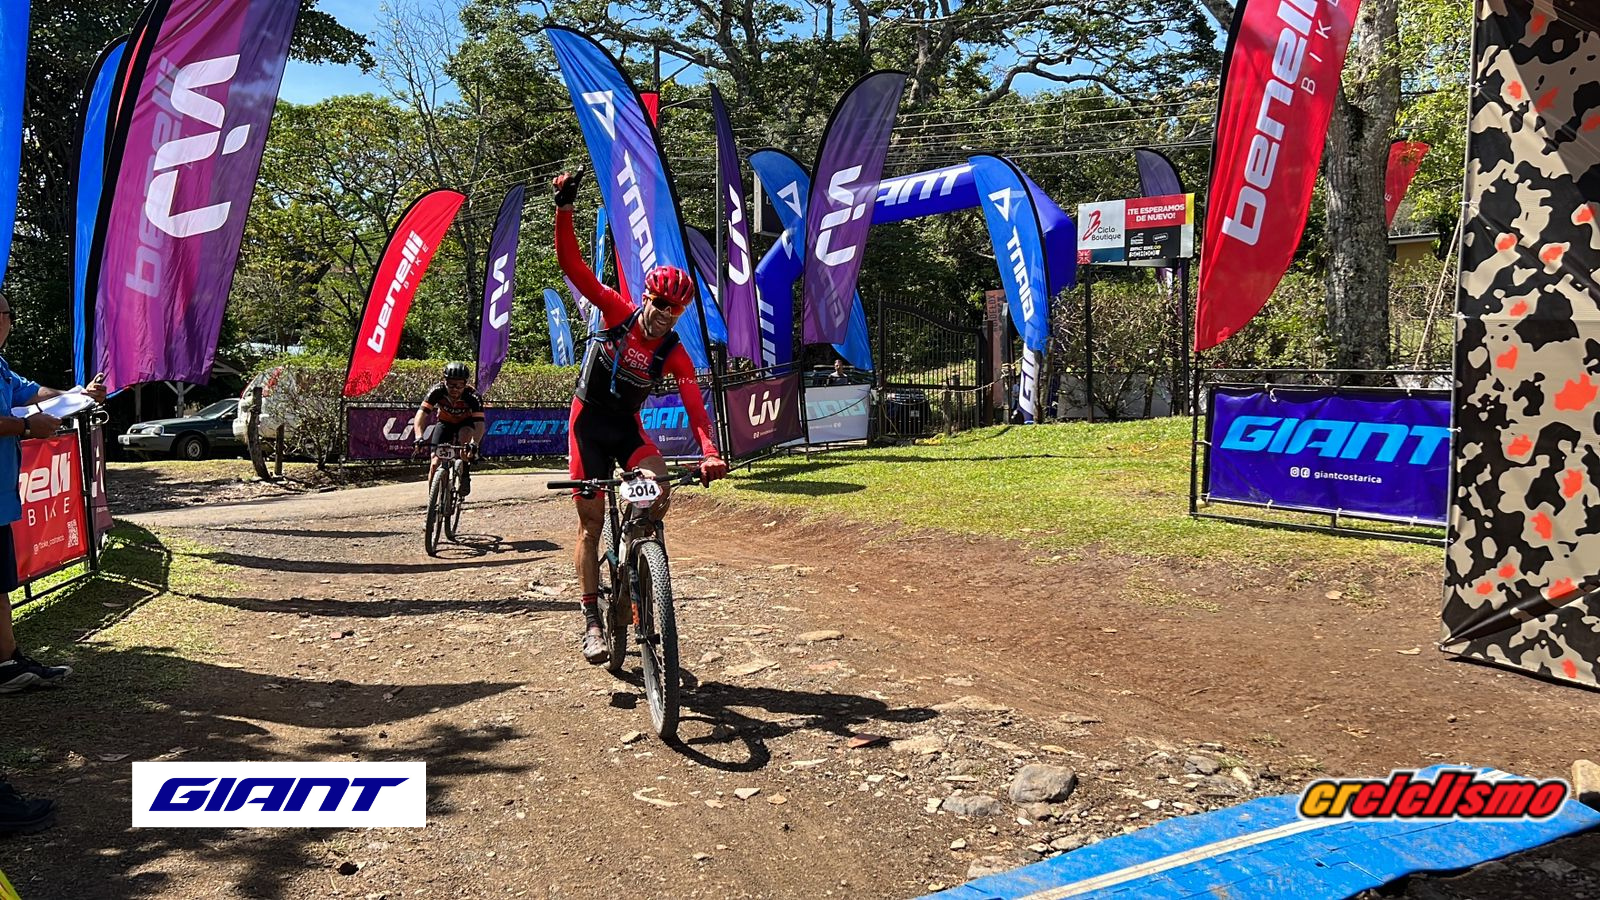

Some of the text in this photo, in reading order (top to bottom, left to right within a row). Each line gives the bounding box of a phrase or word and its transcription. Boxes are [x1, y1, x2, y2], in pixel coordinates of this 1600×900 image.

[1222, 0, 1318, 246] benell
[1136, 212, 1176, 222] DE NUEVO!
[1140, 203, 1185, 214] ESPERAMOS
[1091, 233, 1122, 241] Boutique
[367, 230, 424, 354] benelli
[628, 348, 649, 366] CICL
[640, 406, 690, 430] GIAN
[749, 390, 781, 426] Liv
[1220, 415, 1453, 465] GIANT
[1314, 471, 1382, 484] giantcostarica
[628, 484, 657, 498] 2014
[28, 497, 70, 527] BIKE
